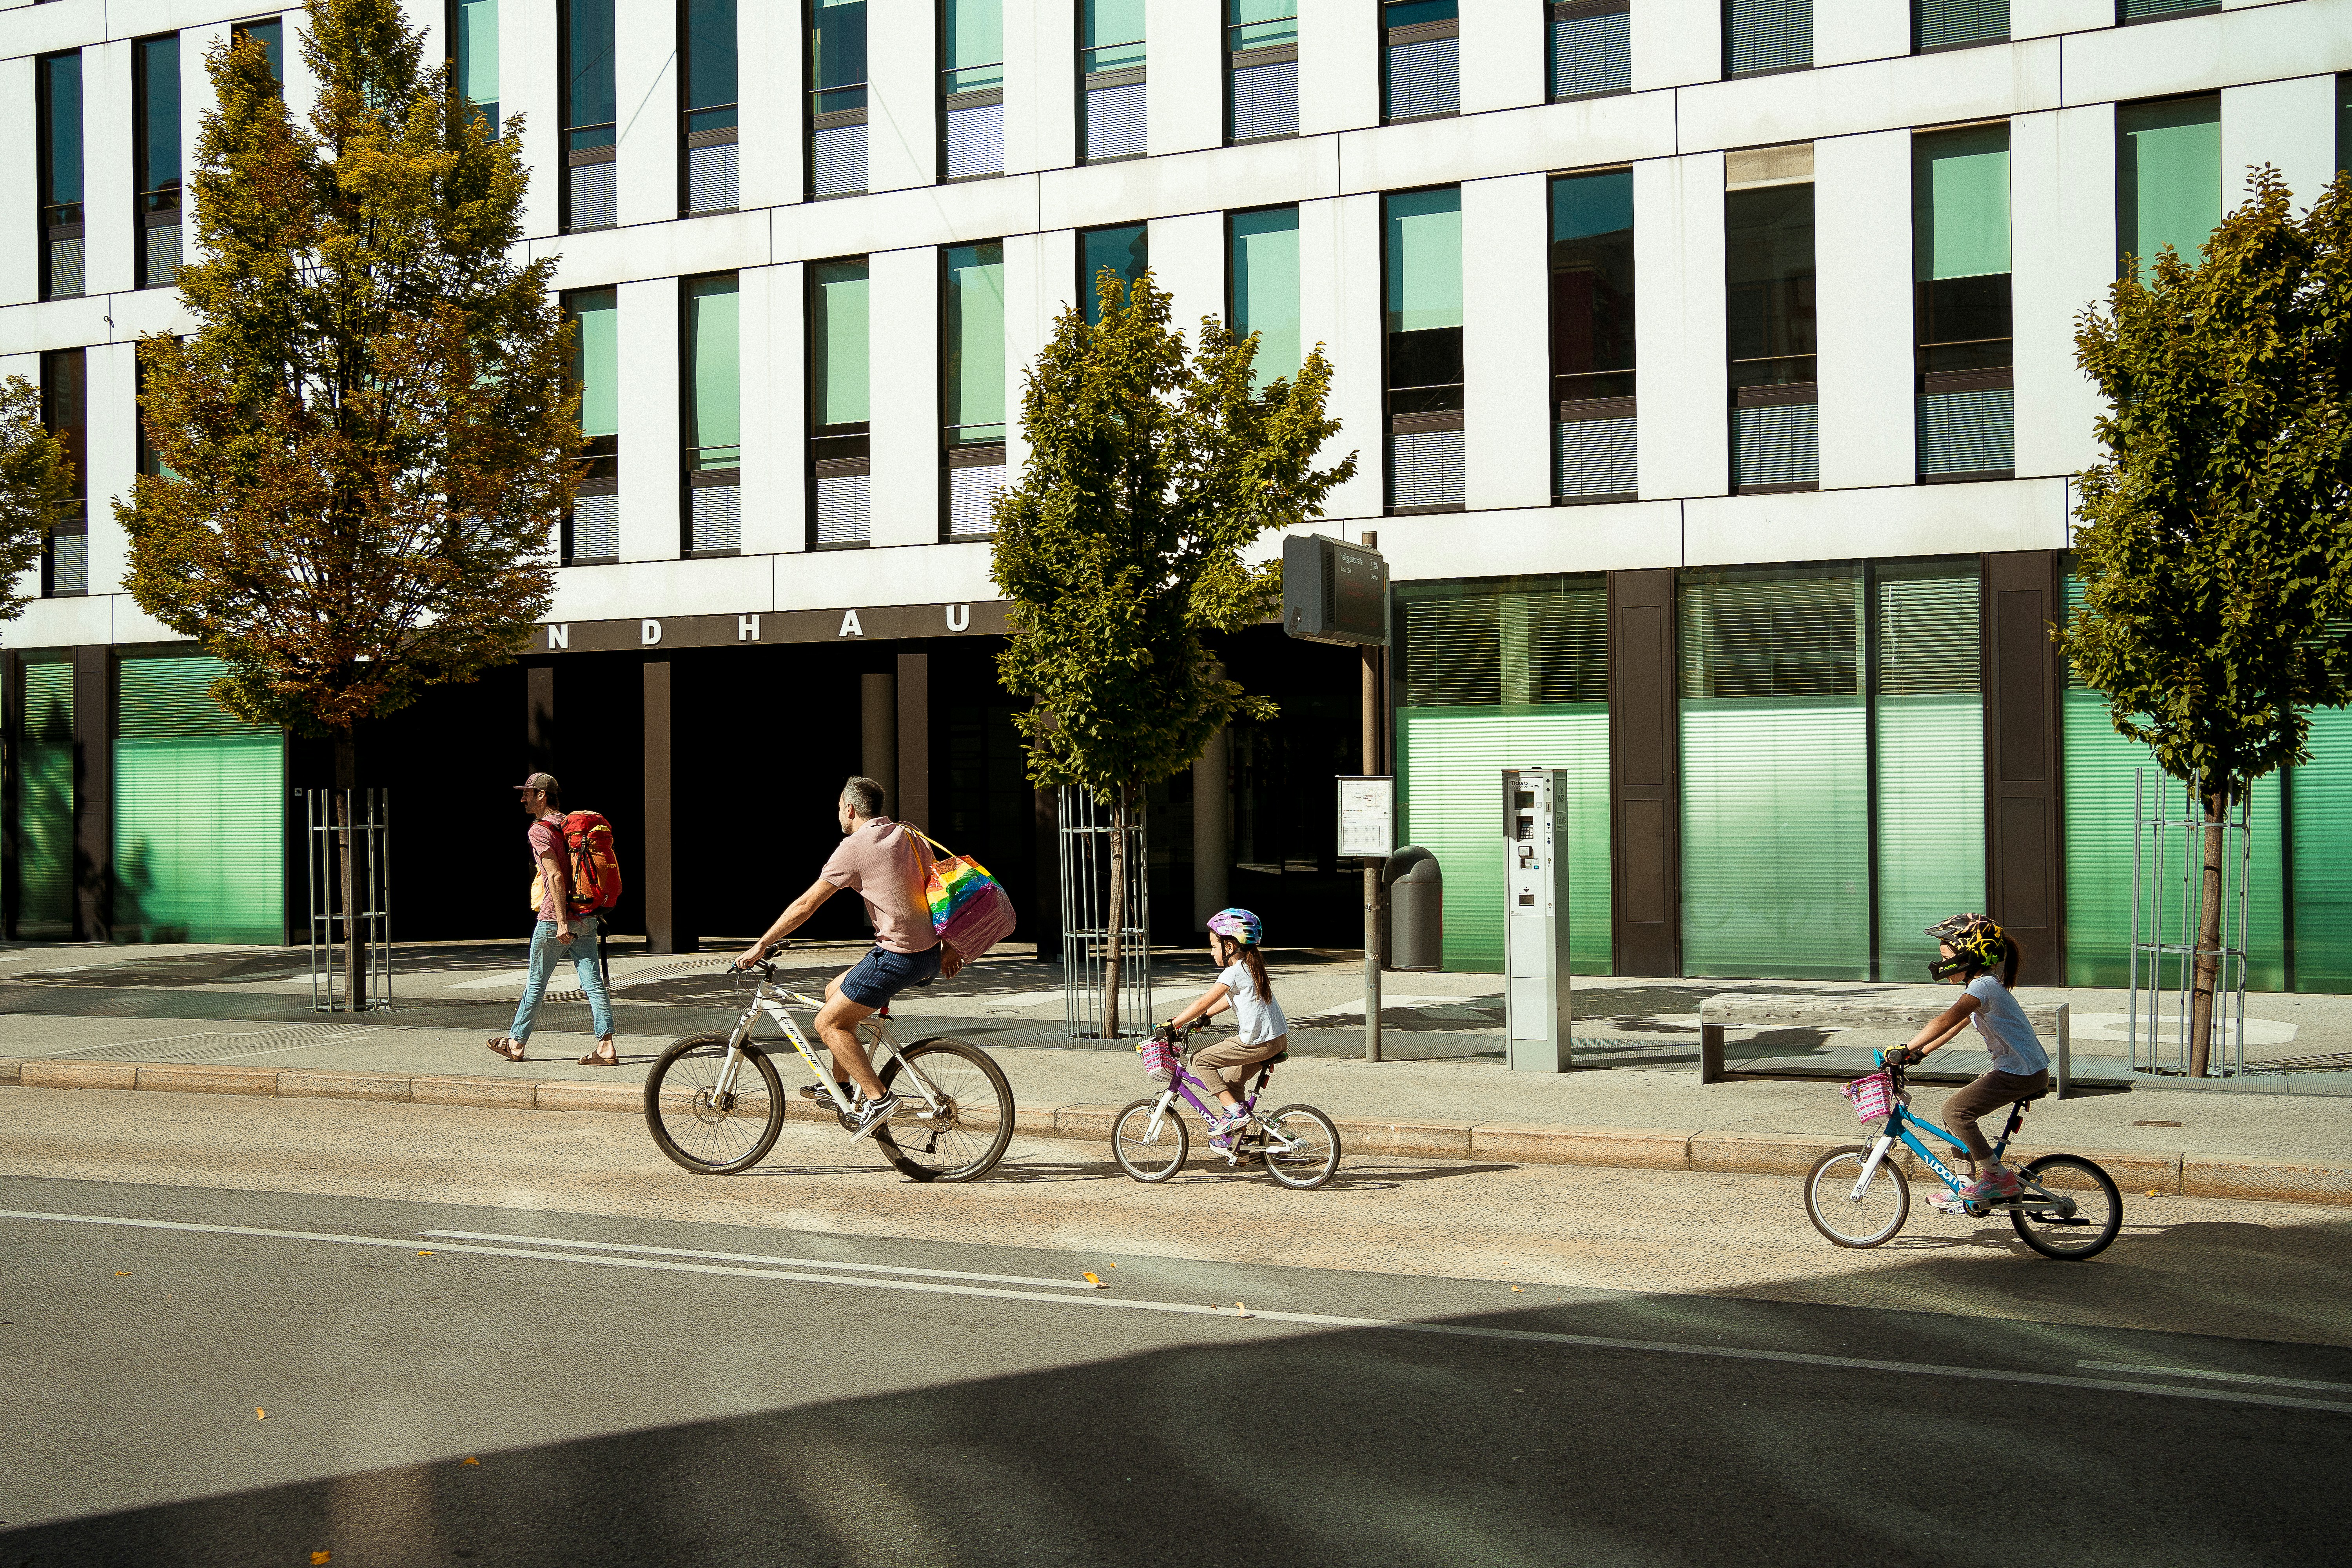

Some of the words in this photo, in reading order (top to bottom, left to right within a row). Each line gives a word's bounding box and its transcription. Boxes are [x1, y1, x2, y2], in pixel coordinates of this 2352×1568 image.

[780, 1016, 820, 1067] CHEYENNE
[1196, 1106, 1218, 1127] woo
[713, 1161, 742, 1172] Continental
[1924, 1154, 1963, 1189] woom
